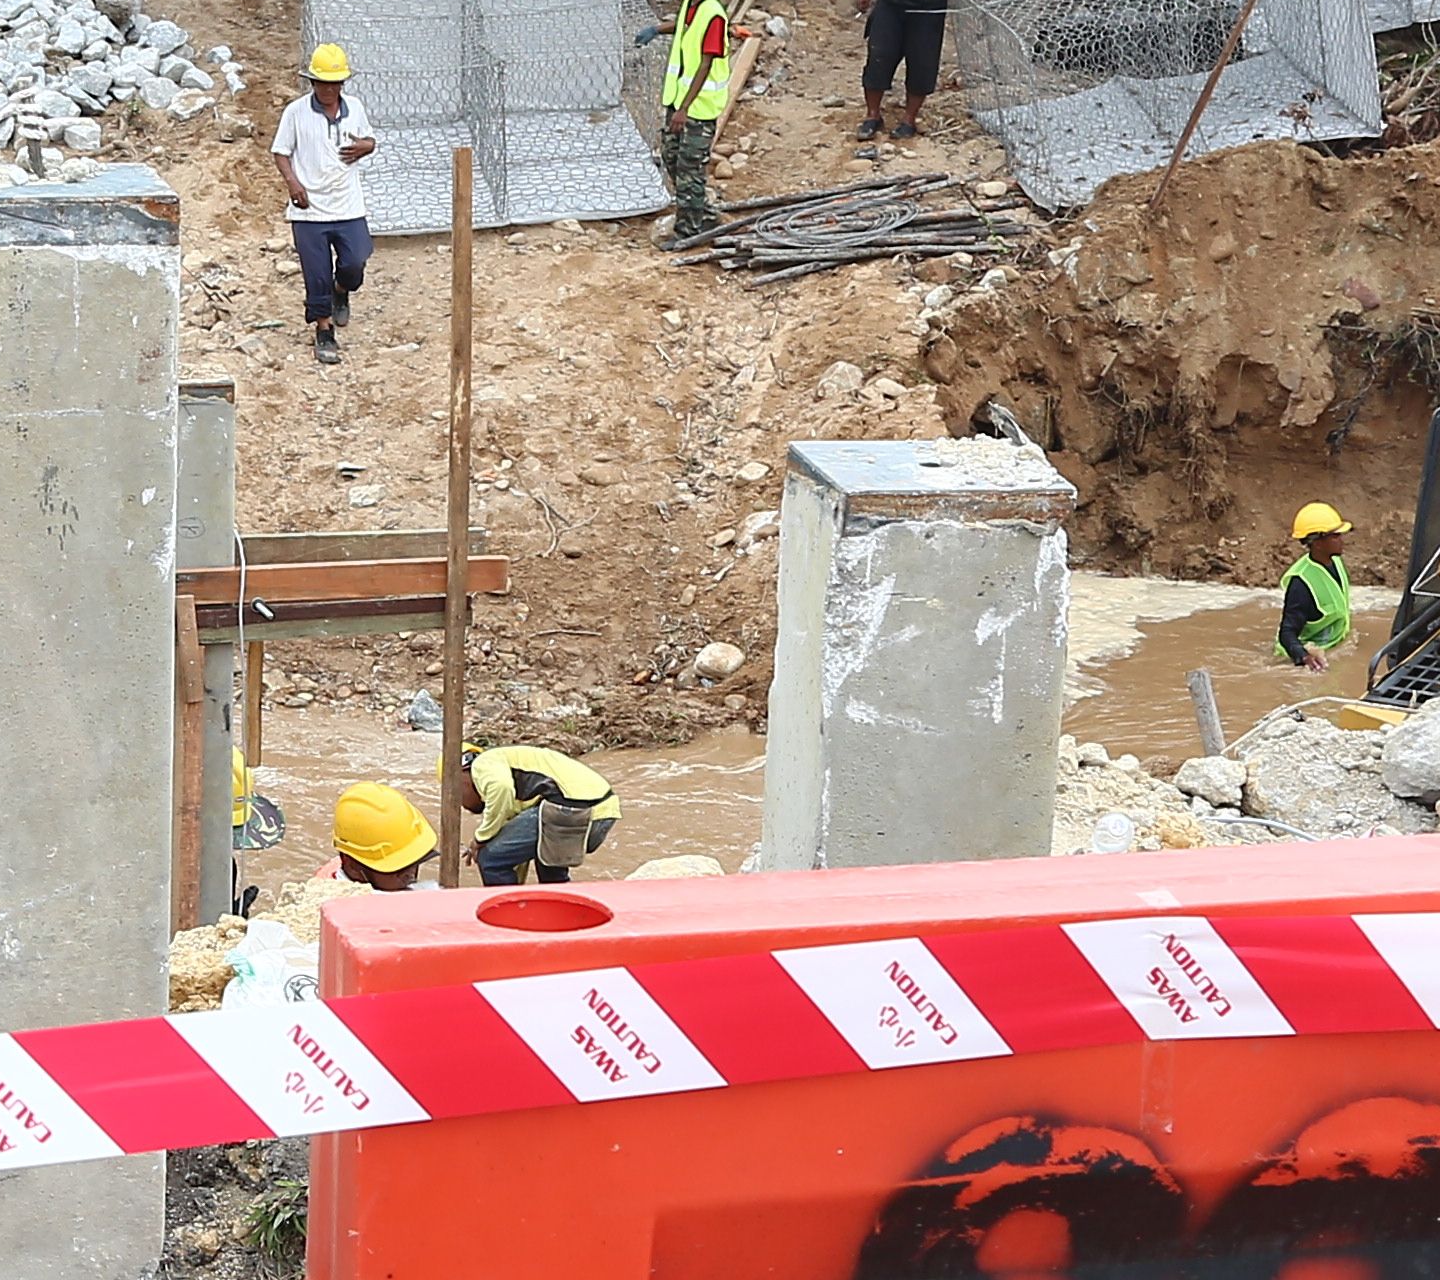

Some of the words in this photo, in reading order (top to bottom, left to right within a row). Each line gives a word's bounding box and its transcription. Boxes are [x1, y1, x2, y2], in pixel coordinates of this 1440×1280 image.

[885, 961, 958, 1045] CAUTION
[1147, 967, 1199, 1023] AWAS
[1161, 934, 1232, 1017] CAUTION
[288, 1024, 370, 1111] CAUTION
[571, 1025, 628, 1082] AWAS
[583, 988, 661, 1074] CAUTION
